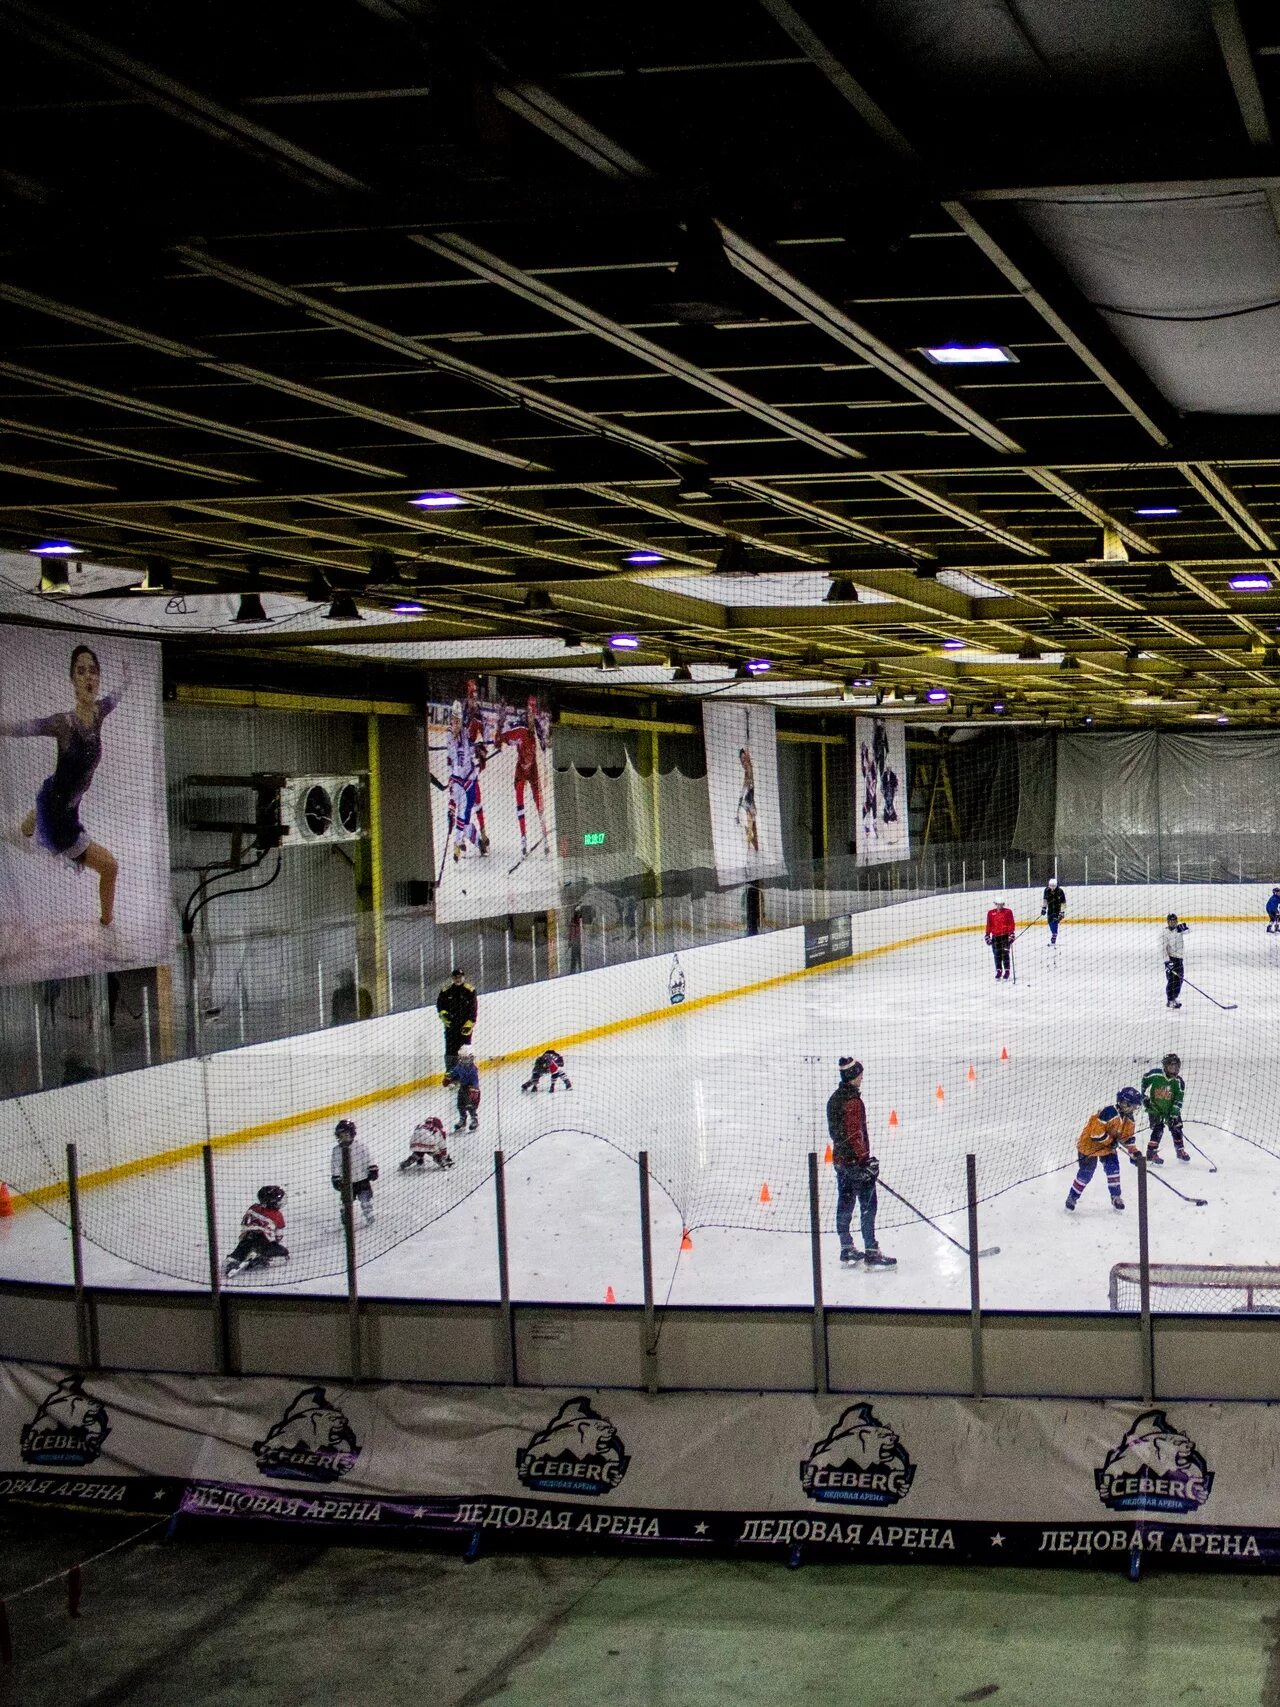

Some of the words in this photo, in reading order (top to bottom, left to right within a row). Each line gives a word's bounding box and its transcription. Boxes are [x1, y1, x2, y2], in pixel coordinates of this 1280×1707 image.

[525, 1456, 618, 1482] ICEBERG
[807, 1467, 907, 1493] ICEBERG
[51, 1481, 127, 1500] АРЕНА
[1104, 1476, 1206, 1499] ICEBERG
[188, 1486, 304, 1514] ЛЕДОВАЯ
[303, 1500, 381, 1521] АРЕНА
[453, 1503, 574, 1532] ЛЕДОВАЯ
[575, 1513, 660, 1537] АРЕНА
[740, 1519, 863, 1544] ЛЕДОВАЯ
[865, 1526, 956, 1550] АРЕНА
[1038, 1530, 1164, 1555] ЛЕДОВАЯ
[1170, 1532, 1260, 1556] АРЕНА
